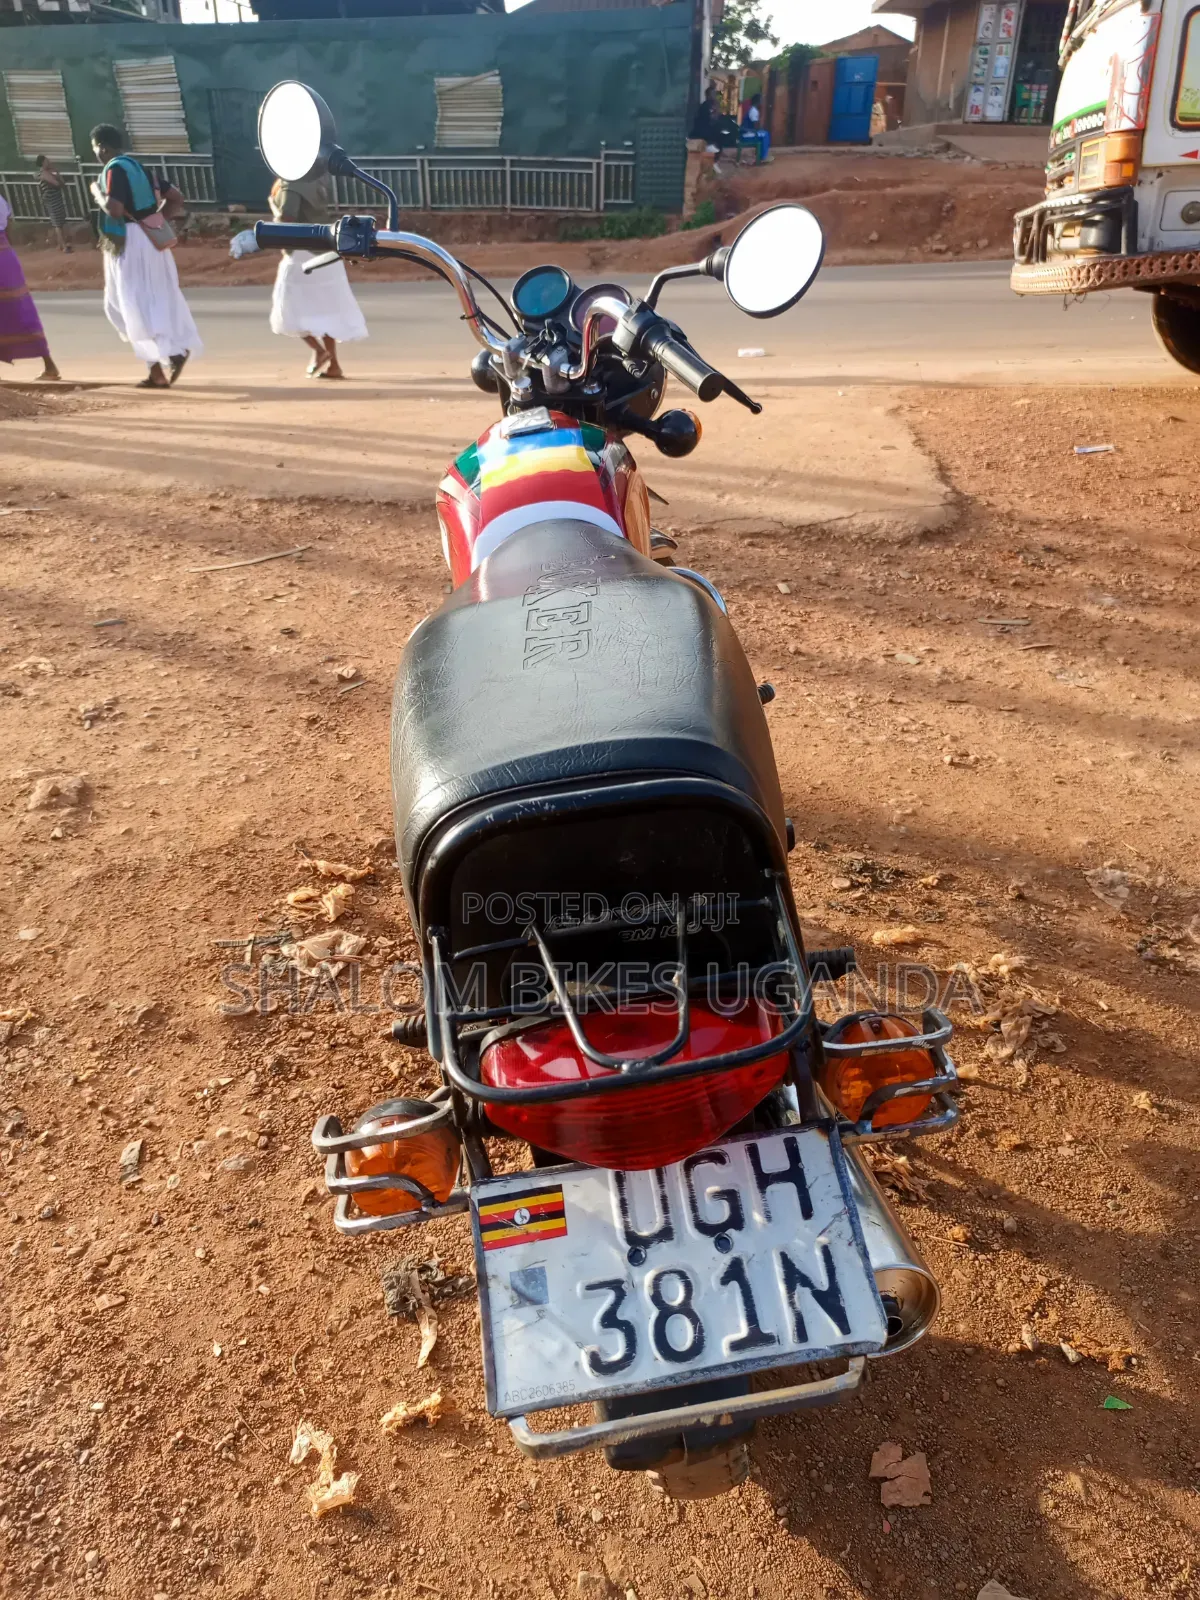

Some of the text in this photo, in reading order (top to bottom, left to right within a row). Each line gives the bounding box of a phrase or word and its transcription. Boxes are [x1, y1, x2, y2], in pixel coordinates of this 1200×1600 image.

[610, 1135, 815, 1249] UGH
[577, 1237, 852, 1376] 381N
[503, 1379, 576, 1403] ABC2606385
